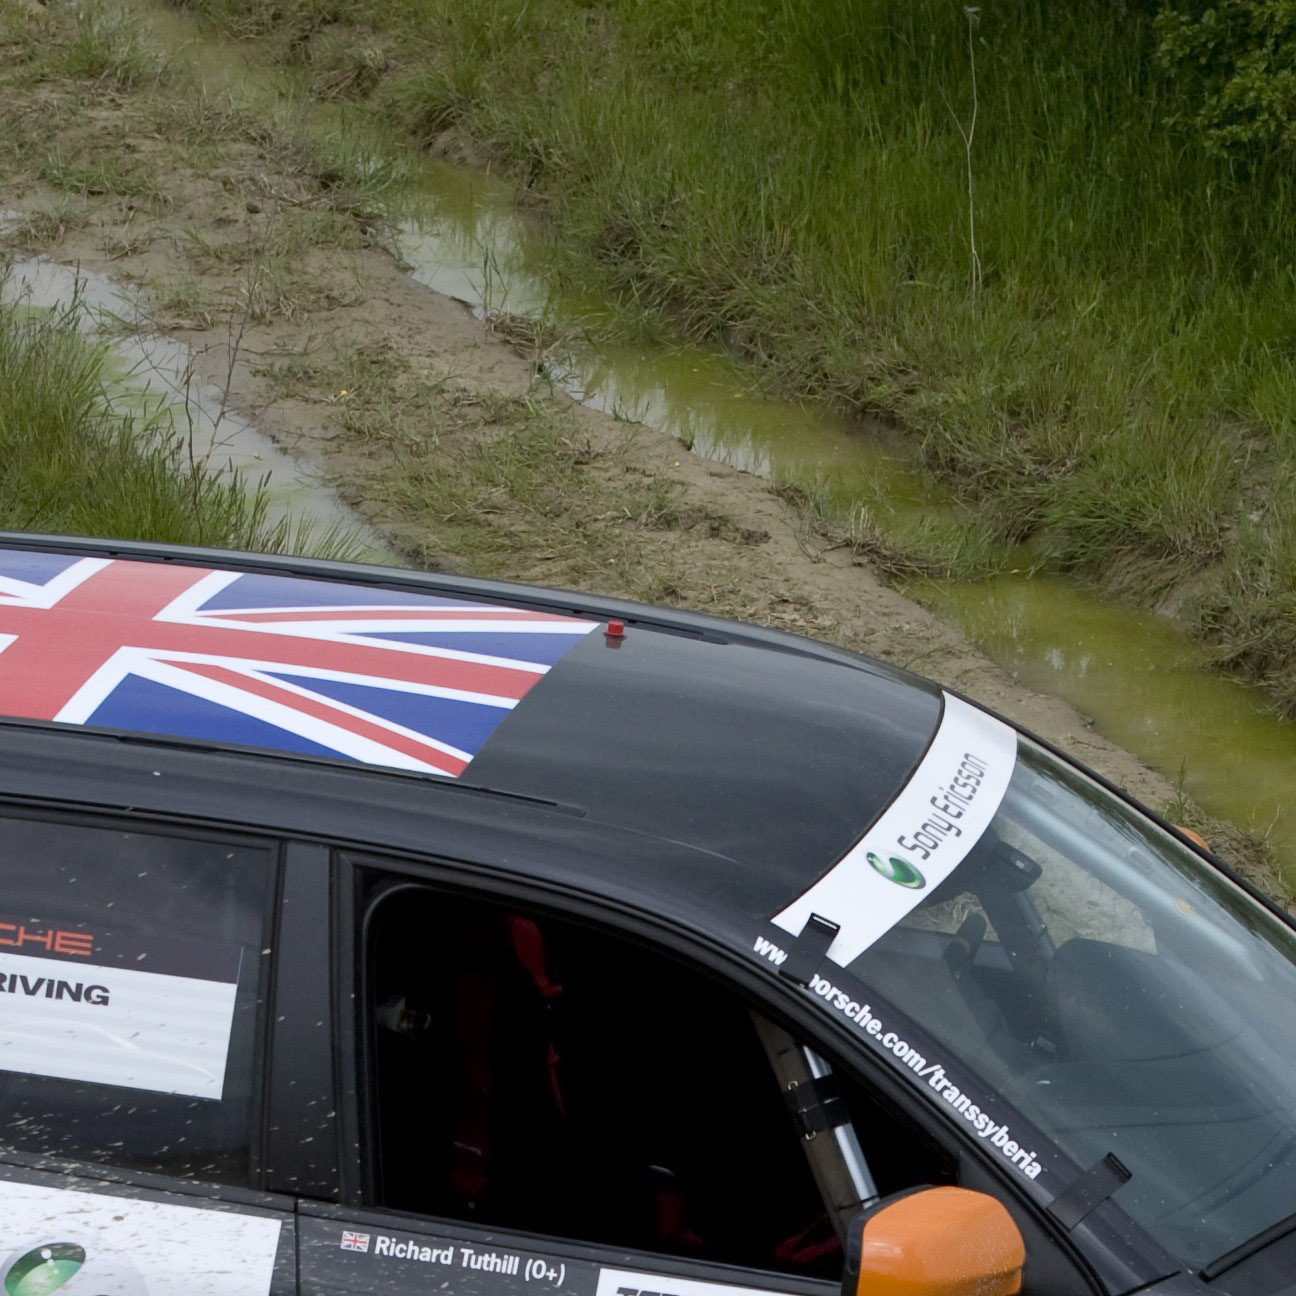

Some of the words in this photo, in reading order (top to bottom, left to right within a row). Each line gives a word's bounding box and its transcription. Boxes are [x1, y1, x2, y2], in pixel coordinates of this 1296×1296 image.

[897, 812, 962, 860] Sony
[930, 752, 988, 819] Ericsson
[374, 1235, 454, 1265] Richard
[460, 1248, 520, 1275] Tuthill
